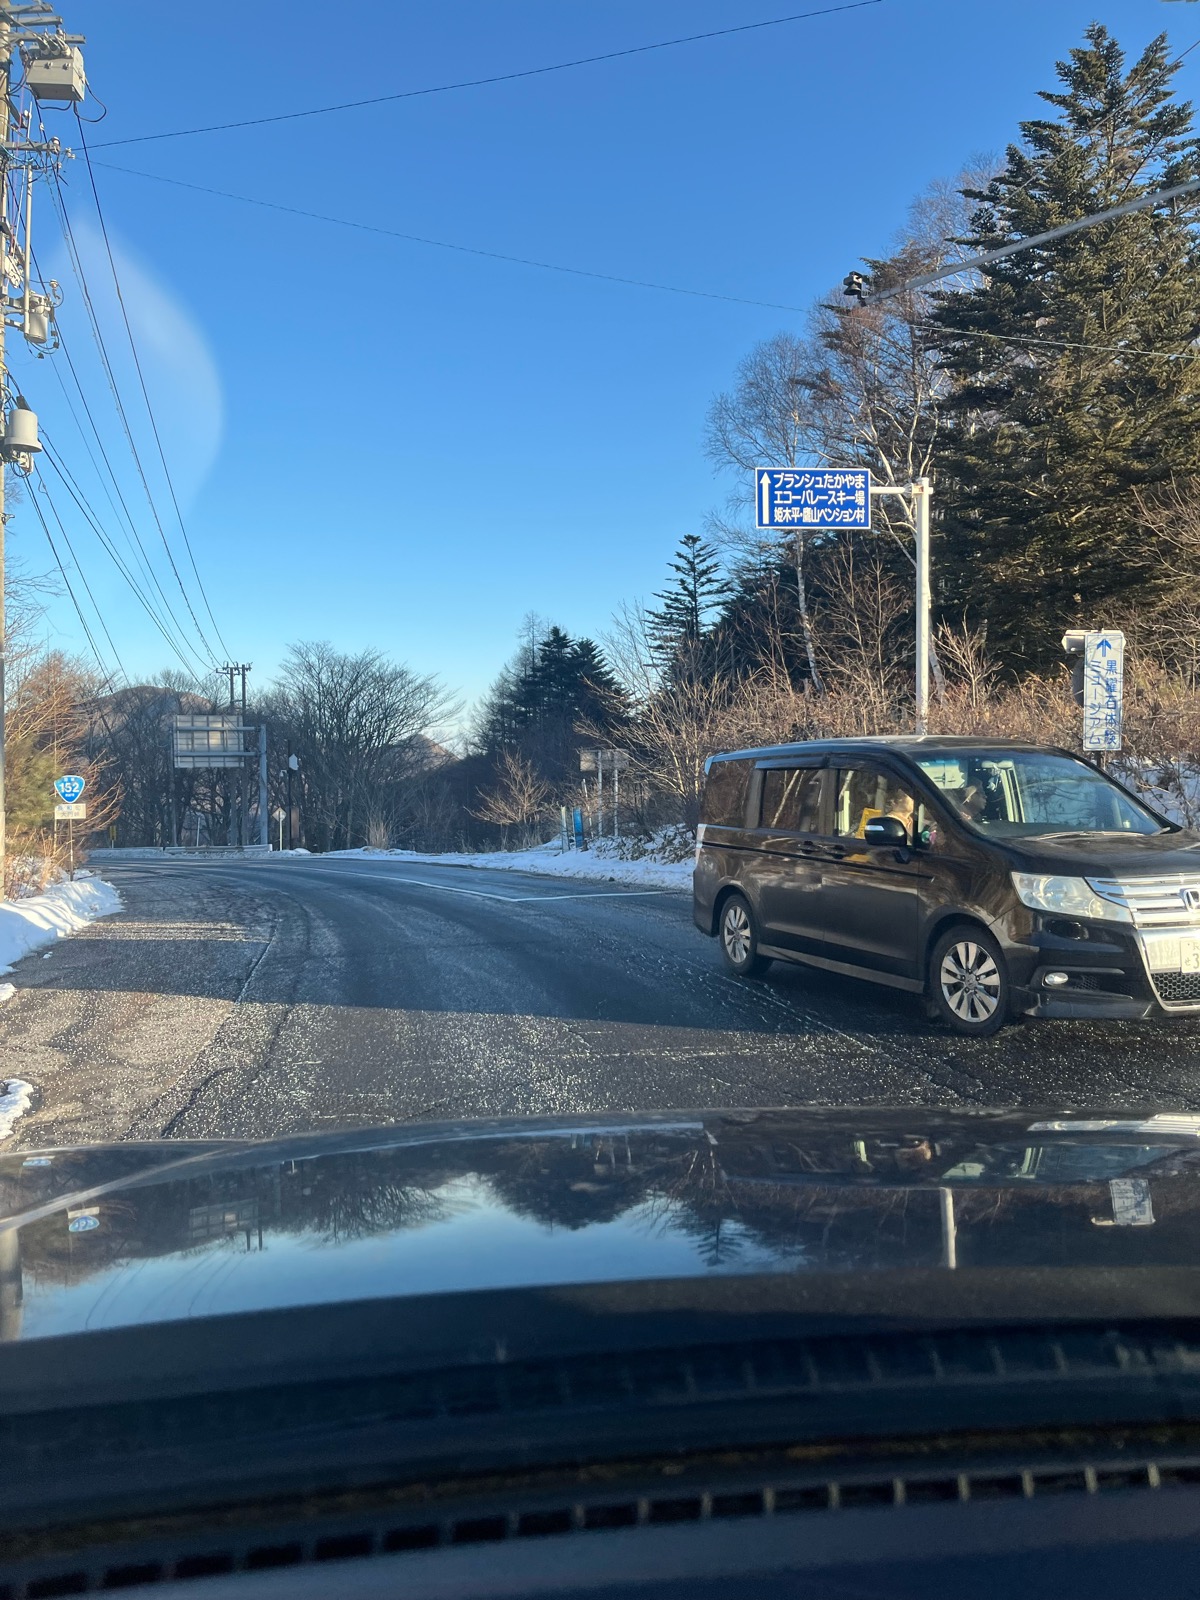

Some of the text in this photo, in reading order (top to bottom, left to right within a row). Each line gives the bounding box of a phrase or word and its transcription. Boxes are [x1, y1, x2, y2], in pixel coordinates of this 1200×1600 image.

[773, 472, 865, 488] ブランシュたかやま
[774, 490, 865, 505] エコーバレースキー場
[1089, 660, 1101, 745] ミュージアム
[59, 782, 79, 793] 152
